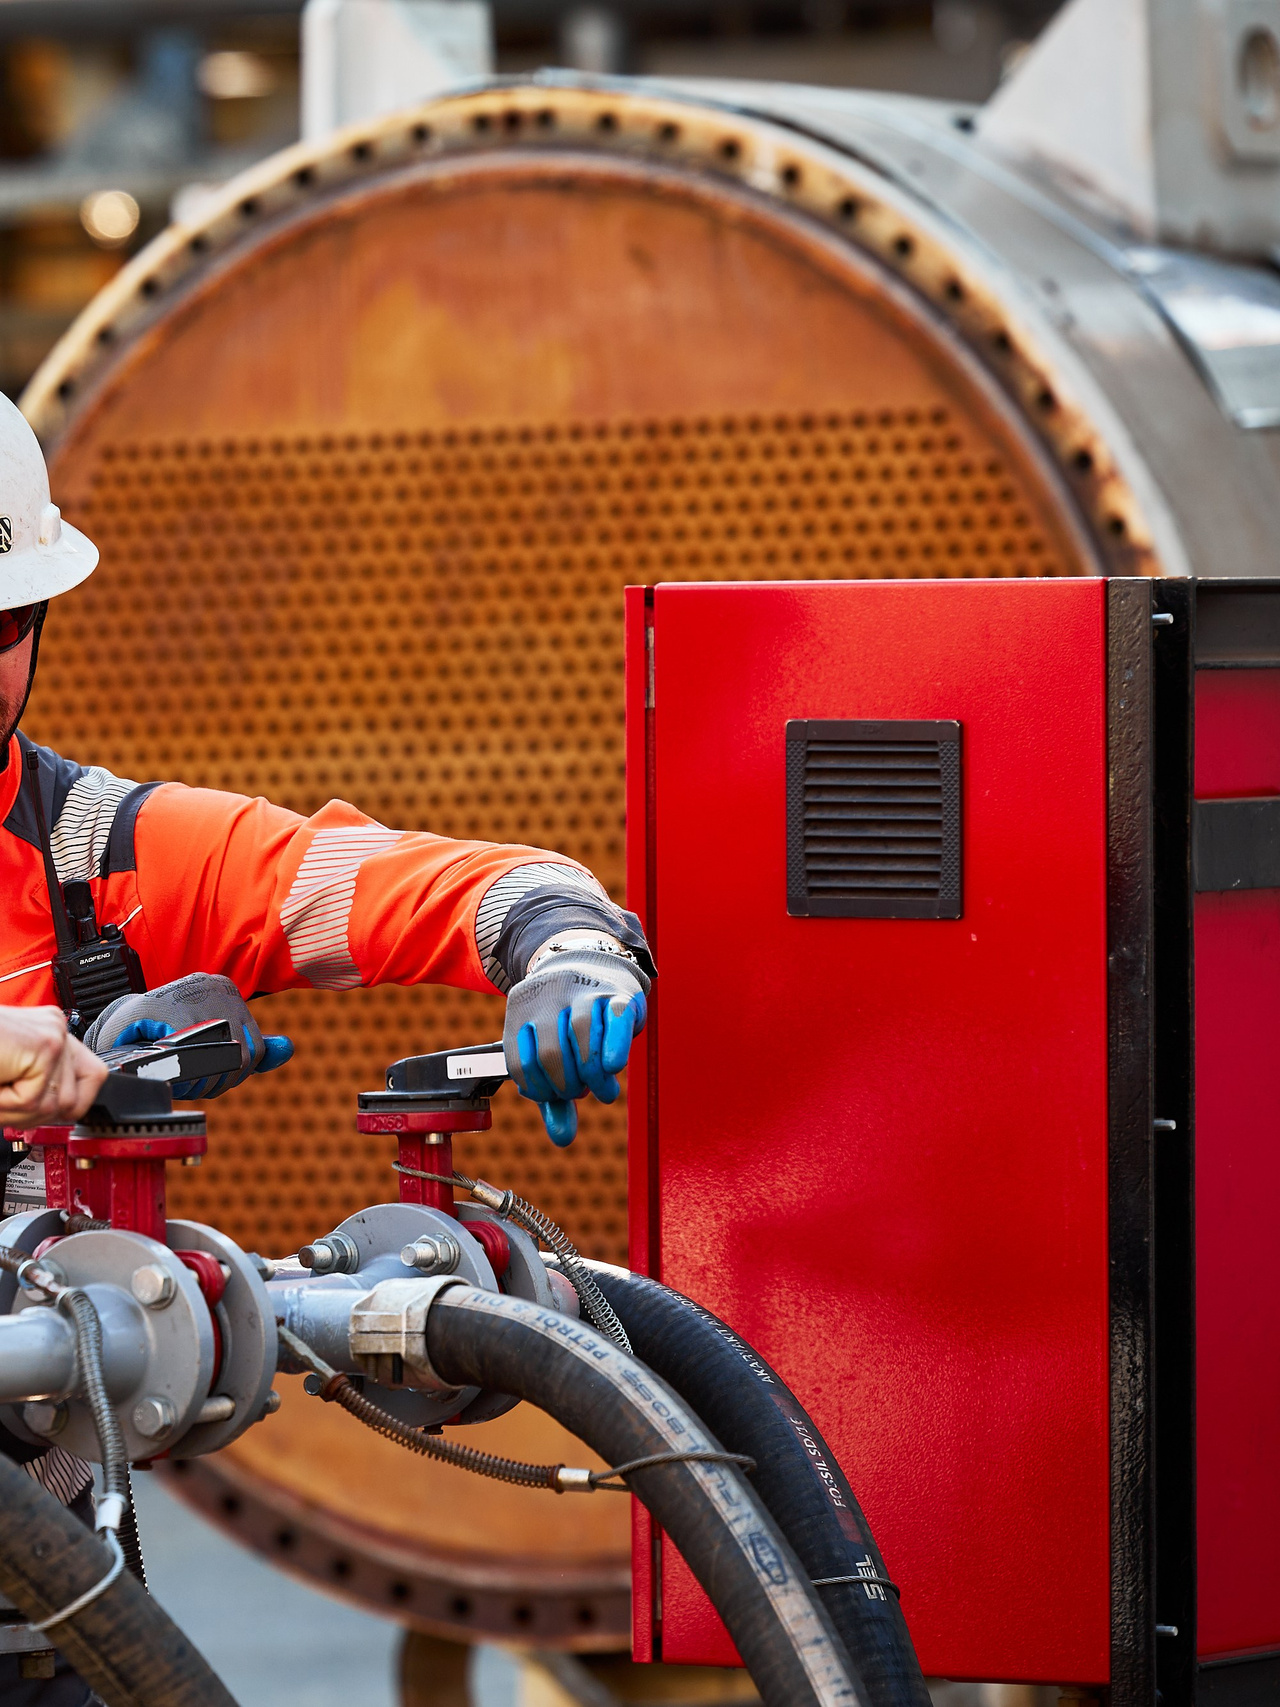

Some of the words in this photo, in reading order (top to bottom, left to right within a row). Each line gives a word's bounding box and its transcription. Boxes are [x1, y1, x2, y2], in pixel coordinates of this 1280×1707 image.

[79, 951, 111, 965] BAOFENG
[14, 1163, 36, 1172] РАМОВ
[471, 1292, 506, 1308] OIL
[535, 1310, 610, 1360] PETROL
[815, 1459, 847, 1508] FOSSIL
